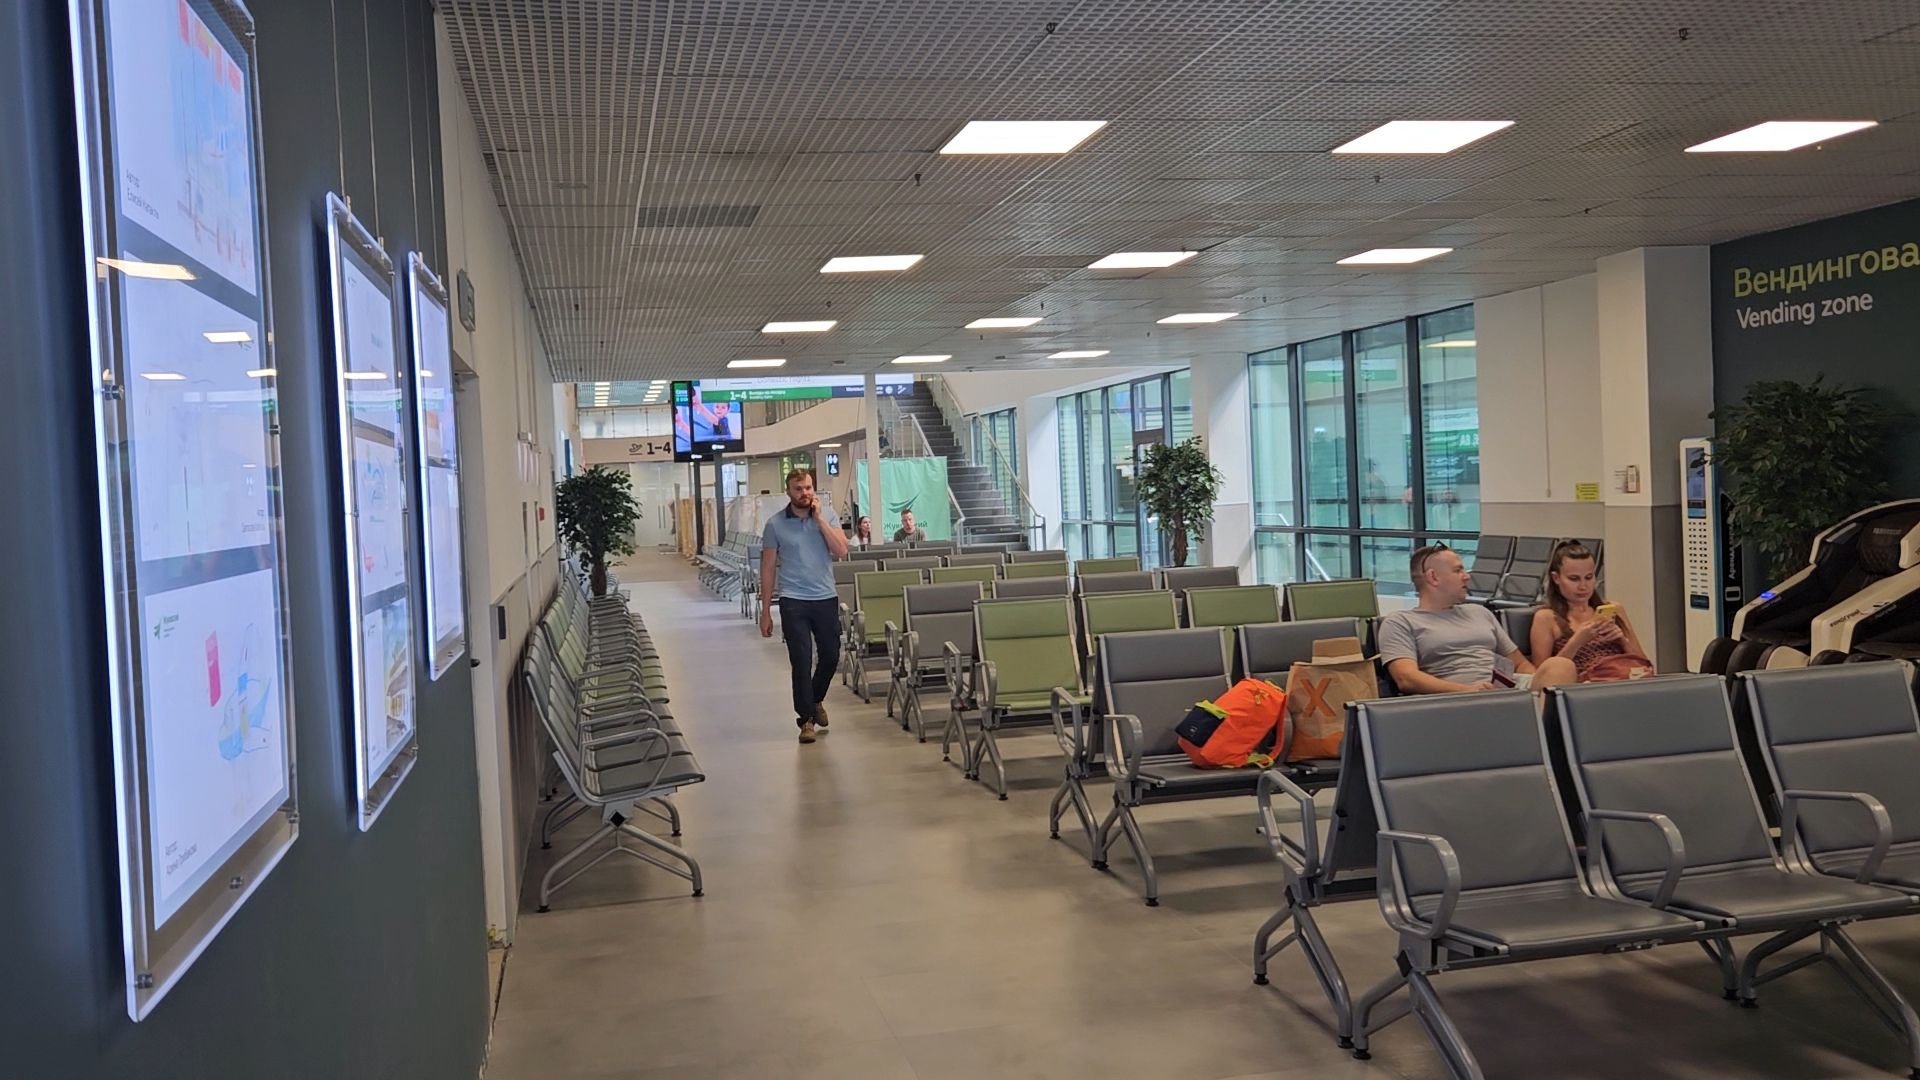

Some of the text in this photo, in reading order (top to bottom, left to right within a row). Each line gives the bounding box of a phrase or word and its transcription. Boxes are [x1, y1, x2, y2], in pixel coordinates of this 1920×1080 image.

[1734, 241, 1920, 298] Вендингова
[1736, 293, 1873, 329] Vending zone
